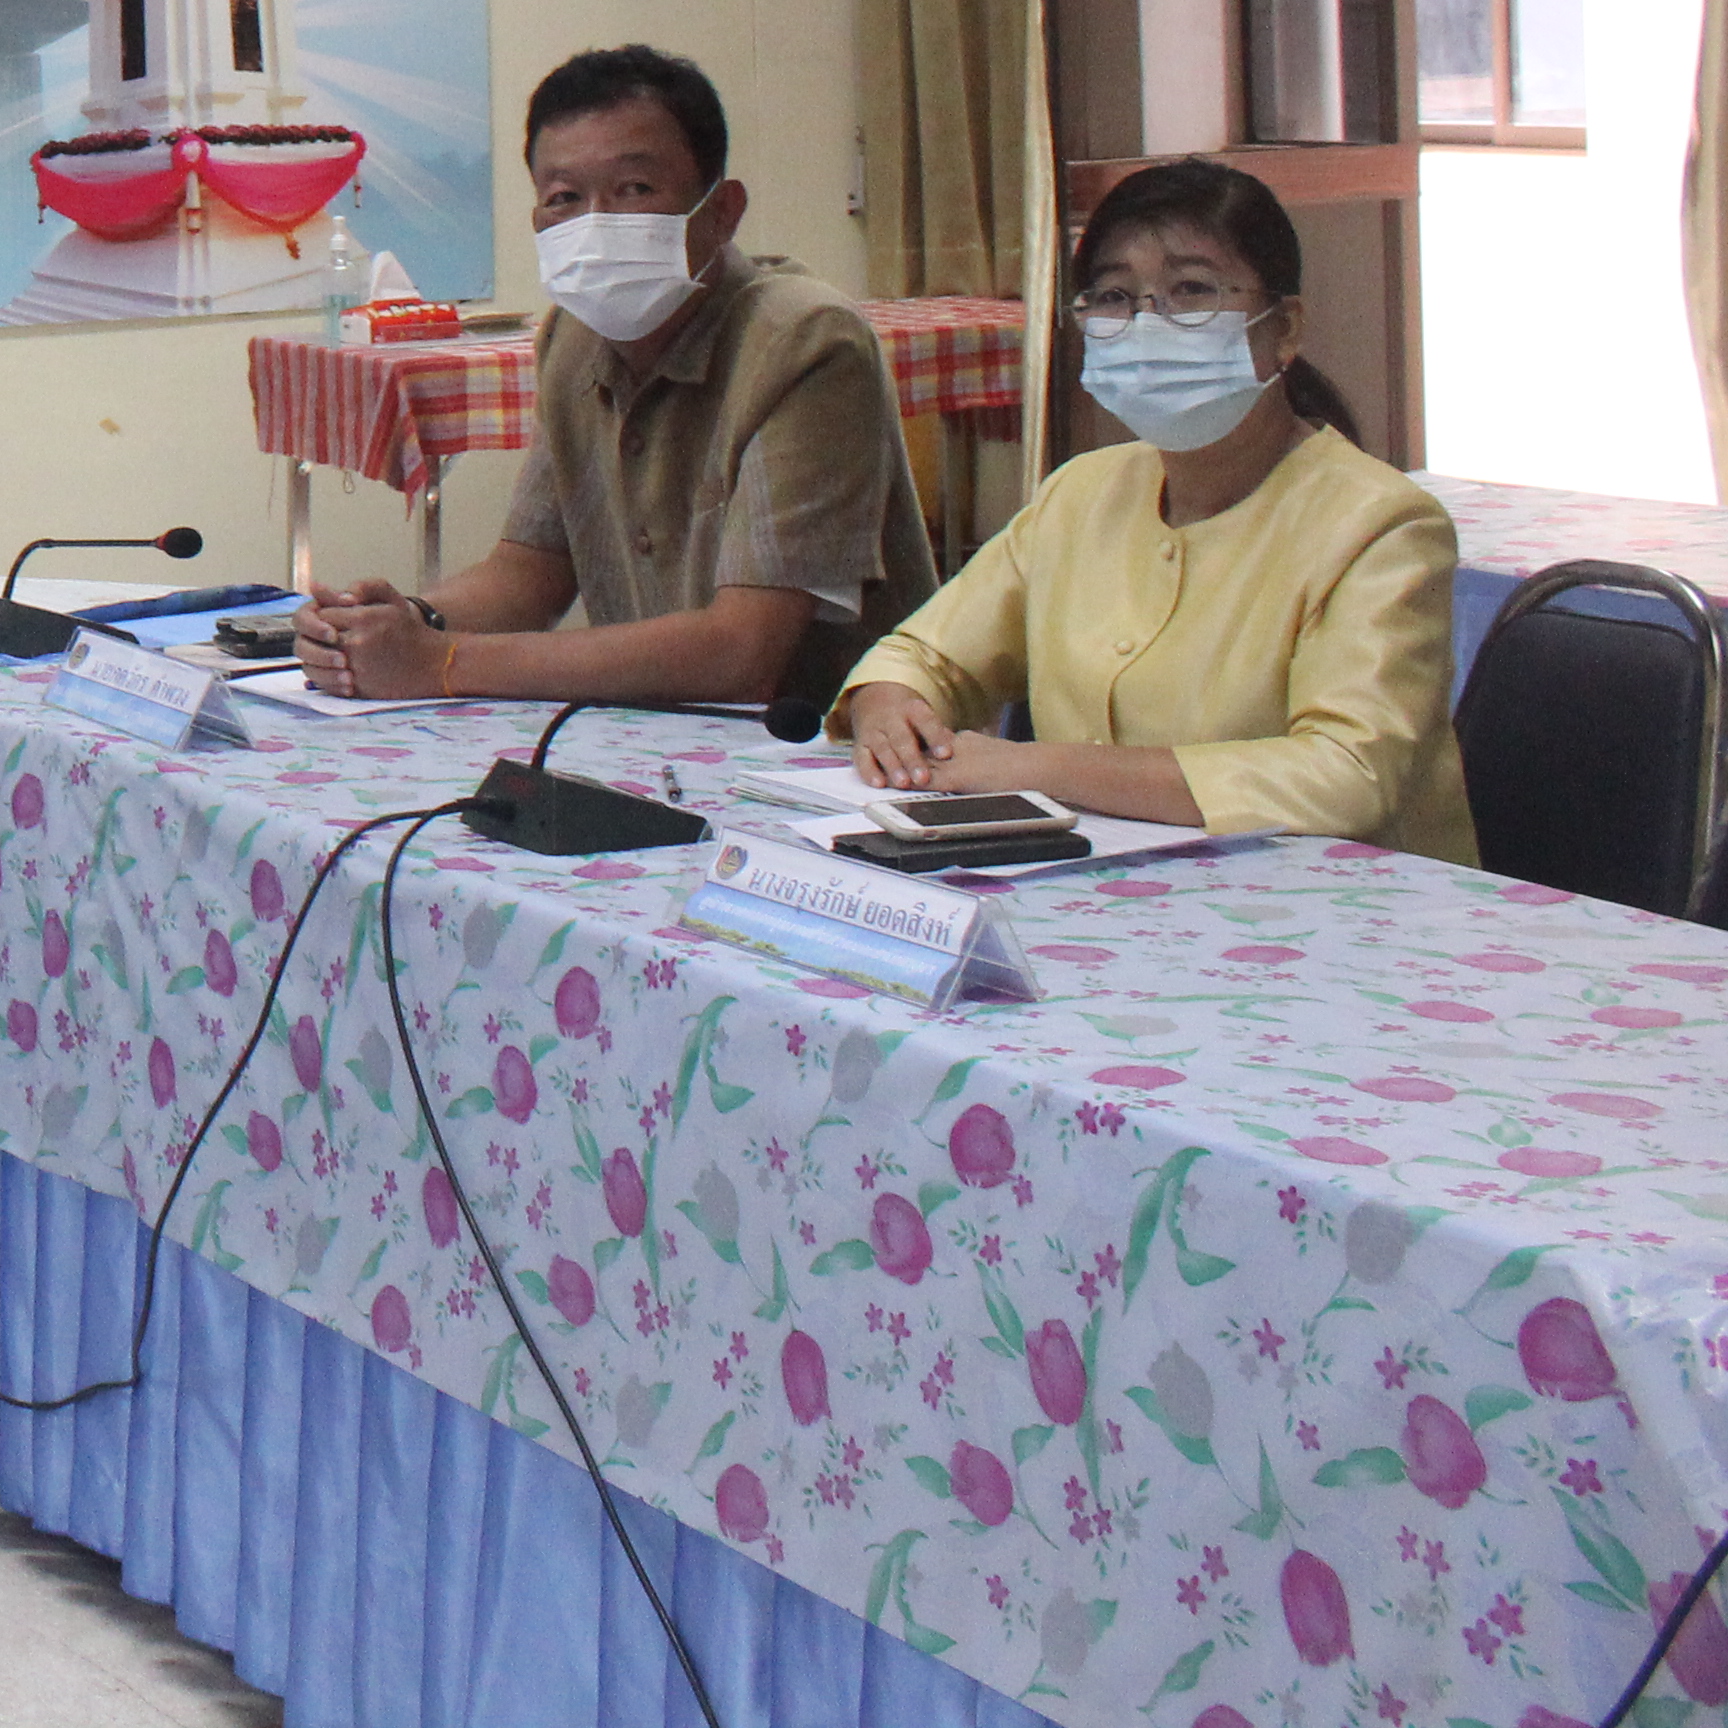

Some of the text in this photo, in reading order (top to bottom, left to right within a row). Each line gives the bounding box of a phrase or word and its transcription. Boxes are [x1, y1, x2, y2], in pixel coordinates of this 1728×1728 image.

[748, 868, 870, 919] นางจรุงรักษ์
